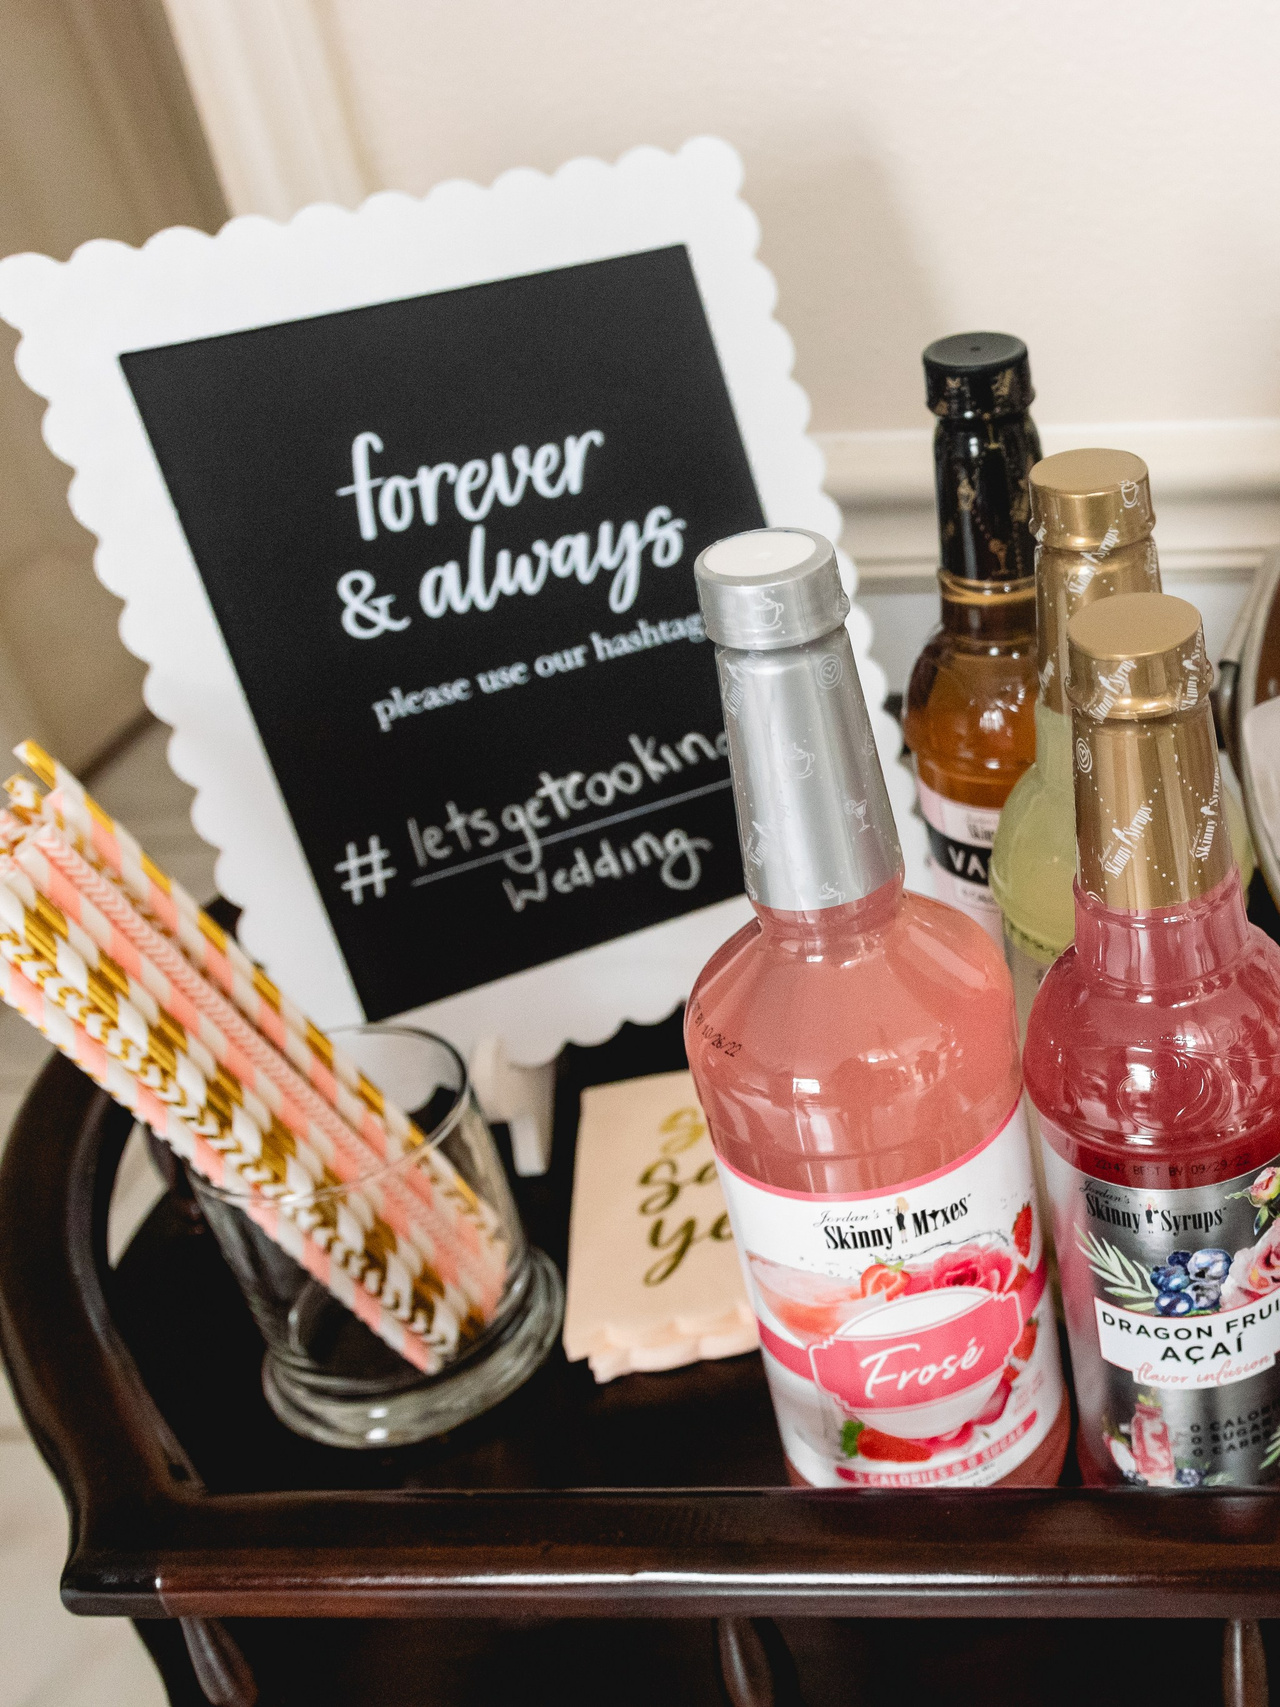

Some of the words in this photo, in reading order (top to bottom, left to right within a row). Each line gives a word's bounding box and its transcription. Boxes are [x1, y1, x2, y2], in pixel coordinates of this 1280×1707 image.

[336, 430, 604, 541] forever
[336, 568, 411, 639] &
[418, 504, 687, 614] always
[371, 678, 473, 732] please
[476, 661, 530, 694] use
[534, 644, 589, 678] our
[590, 612, 708, 661] hashtag
[1079, 1181, 1130, 1204] Jordan's
[813, 1209, 880, 1227] Jordan's
[823, 1225, 893, 1250] Skinny
[911, 1196, 969, 1238] Mixes
[1085, 1193, 1141, 1234] Skinny
[1160, 1208, 1223, 1236] Syrups
[1102, 1310, 1213, 1341] DRAGON
[859, 1336, 985, 1399] Frosé
[1161, 1331, 1244, 1364] AÇAÍ
[1135, 1361, 1189, 1384] flavor
[1196, 1353, 1271, 1386] infusion
